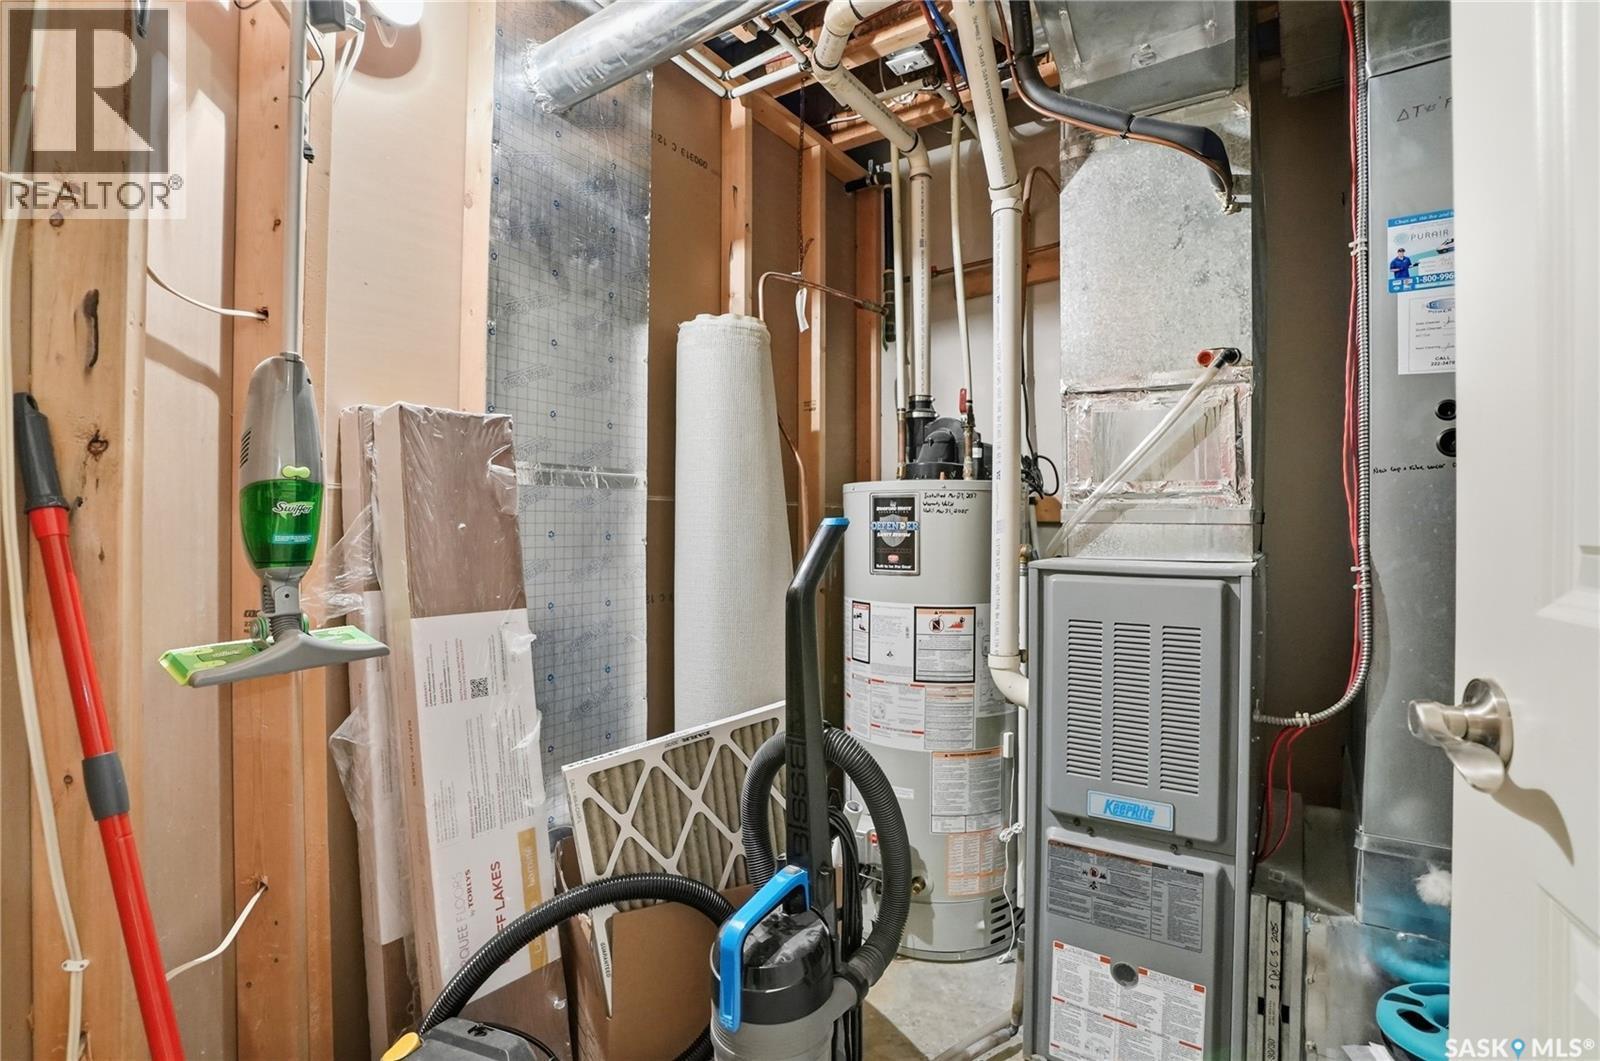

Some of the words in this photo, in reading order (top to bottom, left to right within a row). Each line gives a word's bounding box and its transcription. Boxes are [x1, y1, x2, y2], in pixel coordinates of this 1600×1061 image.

[1411, 229, 1449, 241] PURAIR
[272, 501, 314, 517] Swiffer
[870, 521, 920, 531] DEFENDER
[1103, 799, 1155, 823] KeepRite
[451, 871, 466, 924] FLOORS
[464, 868, 474, 908] TORLYS
[490, 861, 506, 911] LAKES
[600, 942, 611, 978] GUARANTEED
